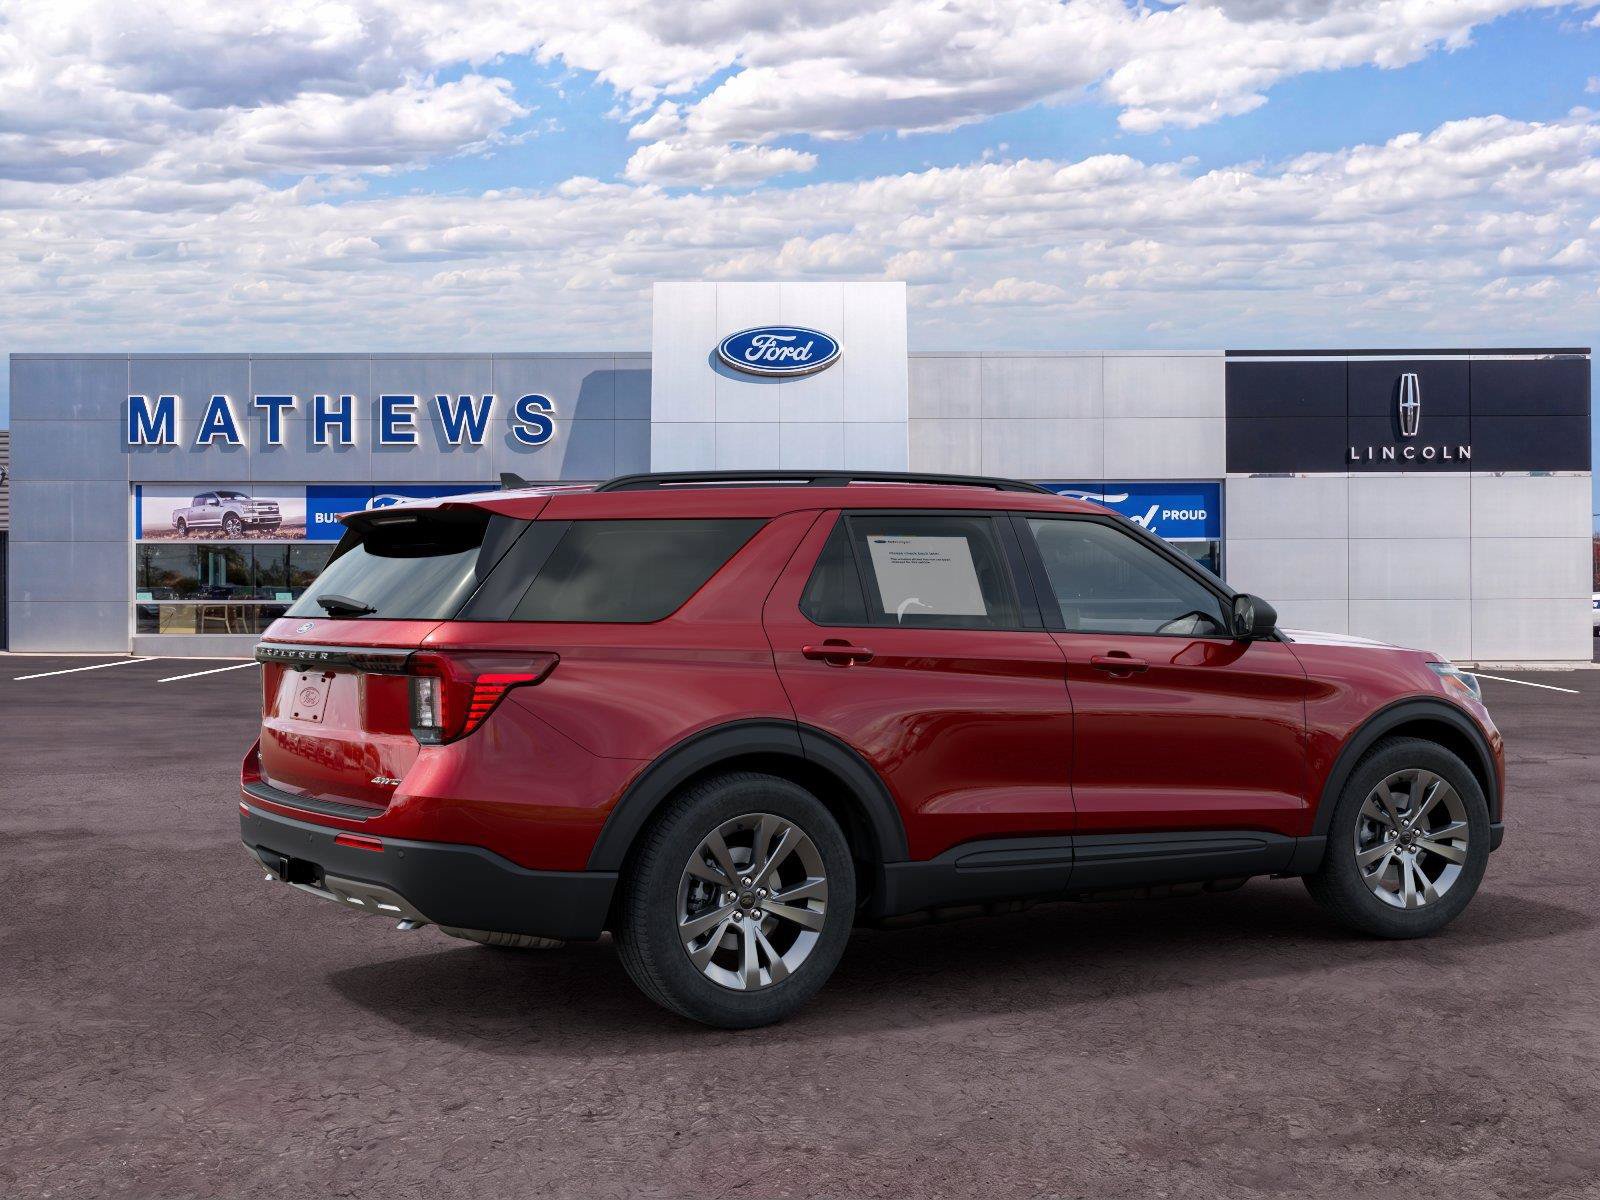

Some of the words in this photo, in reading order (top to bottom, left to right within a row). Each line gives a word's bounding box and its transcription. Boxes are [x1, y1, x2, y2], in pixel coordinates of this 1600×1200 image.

[744, 334, 814, 361] Ford
[127, 394, 556, 446] MATHEWS
[1351, 446, 1472, 460] LINCOLN
[1162, 509, 1208, 521] PROUD
